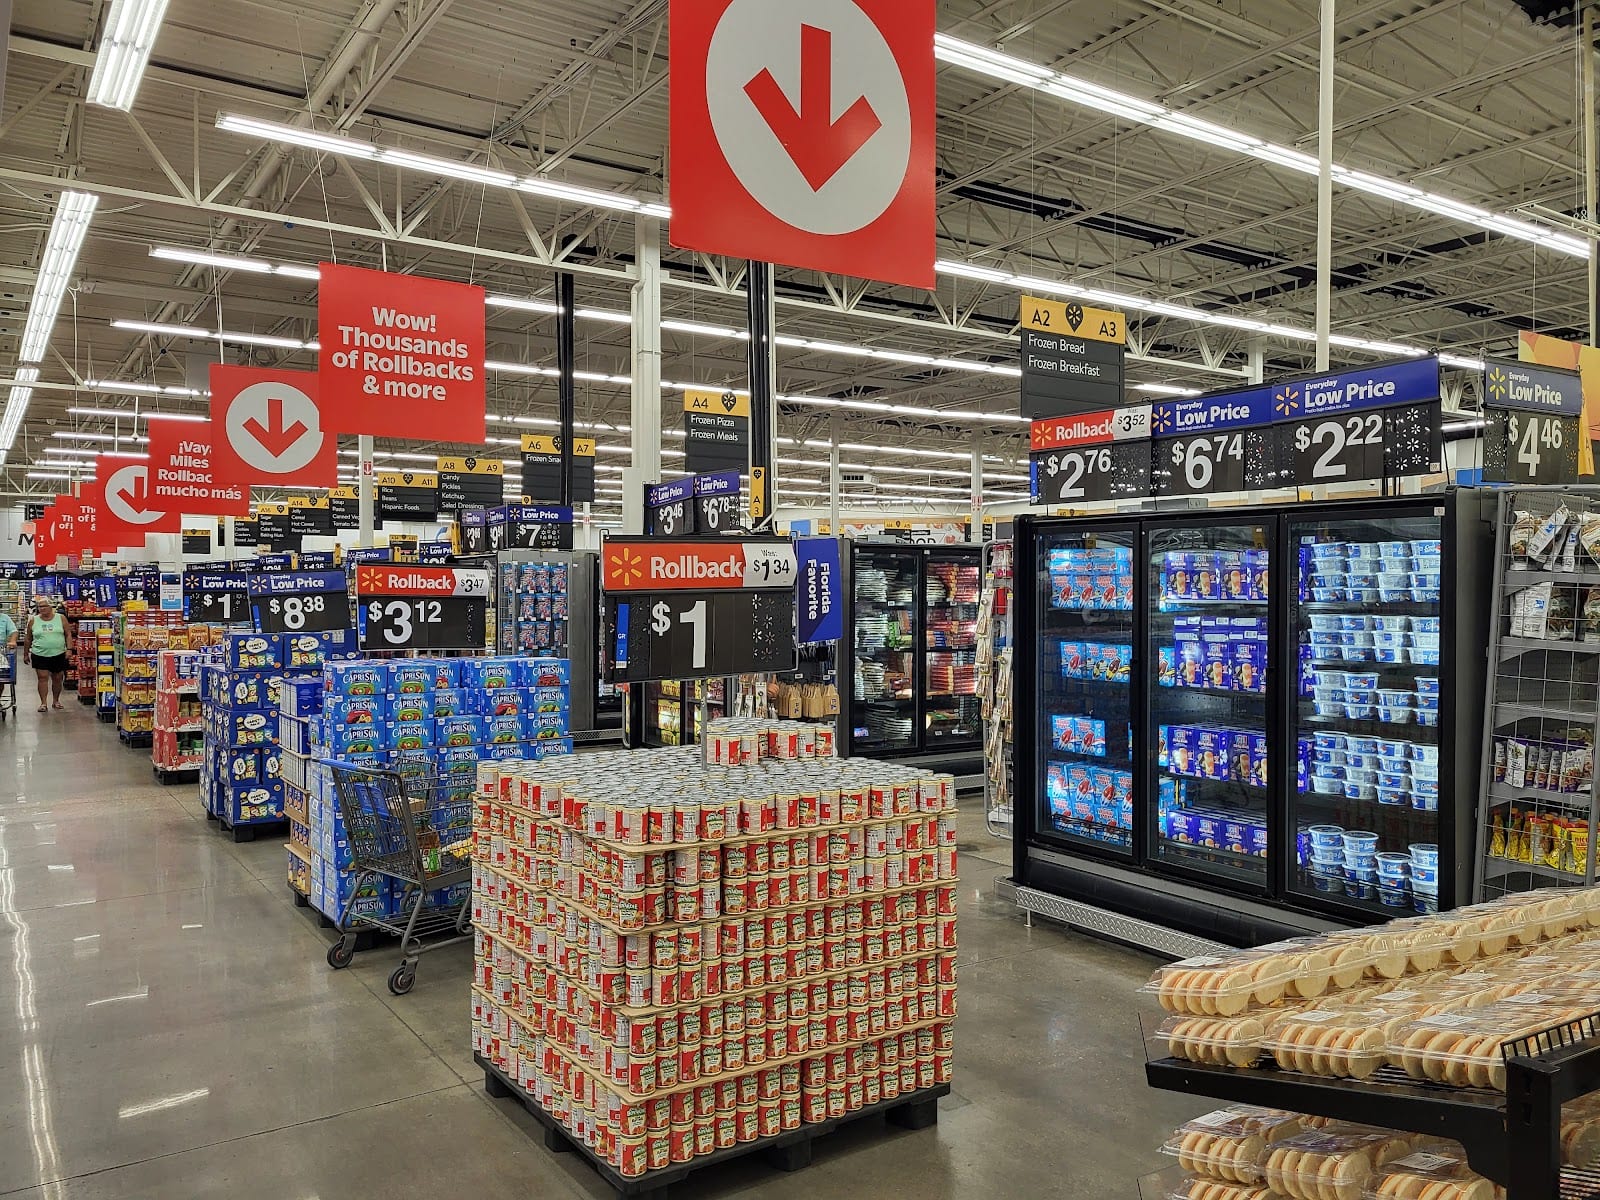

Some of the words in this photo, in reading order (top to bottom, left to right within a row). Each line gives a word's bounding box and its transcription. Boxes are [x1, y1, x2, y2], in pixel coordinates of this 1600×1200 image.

[372, 306, 437, 333] Wow!
[1031, 308, 1050, 327] A2
[1099, 320, 1117, 338] A3
[338, 325, 469, 359] Thousands
[1028, 333, 1058, 350] Frozen
[1060, 338, 1085, 354] Bread
[331, 350, 359, 369] of
[363, 351, 474, 382] Rollbacks
[1028, 354, 1058, 371] Frozen
[1060, 360, 1101, 377] Breakfast
[1508, 371, 1530, 383] Everyday
[362, 374, 380, 395] &
[384, 380, 447, 400] more
[1305, 379, 1337, 391] Everyday
[1305, 389, 1343, 408] Low
[1346, 379, 1396, 402] Price
[1508, 380, 1533, 402] Low
[1534, 384, 1562, 405] Price
[692, 397, 709, 408] A4
[1175, 401, 1203, 411] Everyday
[691, 415, 716, 425] Frozen
[717, 417, 734, 427] Pizza
[1176, 407, 1209, 427] Low
[1211, 404, 1250, 423] Price
[691, 429, 716, 440] Frozen
[717, 431, 738, 442] Meals
[1055, 418, 1112, 441] Rollback
[179, 440, 212, 456] ¡Vay
[528, 440, 541, 450] A6
[576, 444, 588, 453] A7
[170, 454, 209, 468] Miles
[526, 454, 547, 462] Frozen
[443, 462, 455, 470] A8
[486, 464, 498, 472] A9
[381, 476, 396, 484] A10
[421, 478, 433, 486] A11
[441, 473, 460, 481] Candy
[701, 480, 713, 491] Low
[713, 479, 728, 490] Price
[156, 485, 209, 498] mucho
[211, 487, 242, 500] más
[441, 493, 465, 501] Ketchup
[658, 490, 669, 501] Low
[669, 486, 682, 497] Price
[381, 504, 403, 512] Hispanic
[458, 503, 484, 511] Dressings
[522, 511, 538, 519] Low
[540, 511, 559, 519] Price
[519, 524, 541, 547] $7
[650, 555, 743, 580] Rollback
[202, 580, 225, 589] Low
[270, 575, 291, 583] Everyday
[271, 579, 295, 591] Low
[296, 577, 325, 589] Price
[388, 573, 452, 590] Rollback
[806, 558, 818, 621] Favorite
[820, 561, 832, 615] Florida
